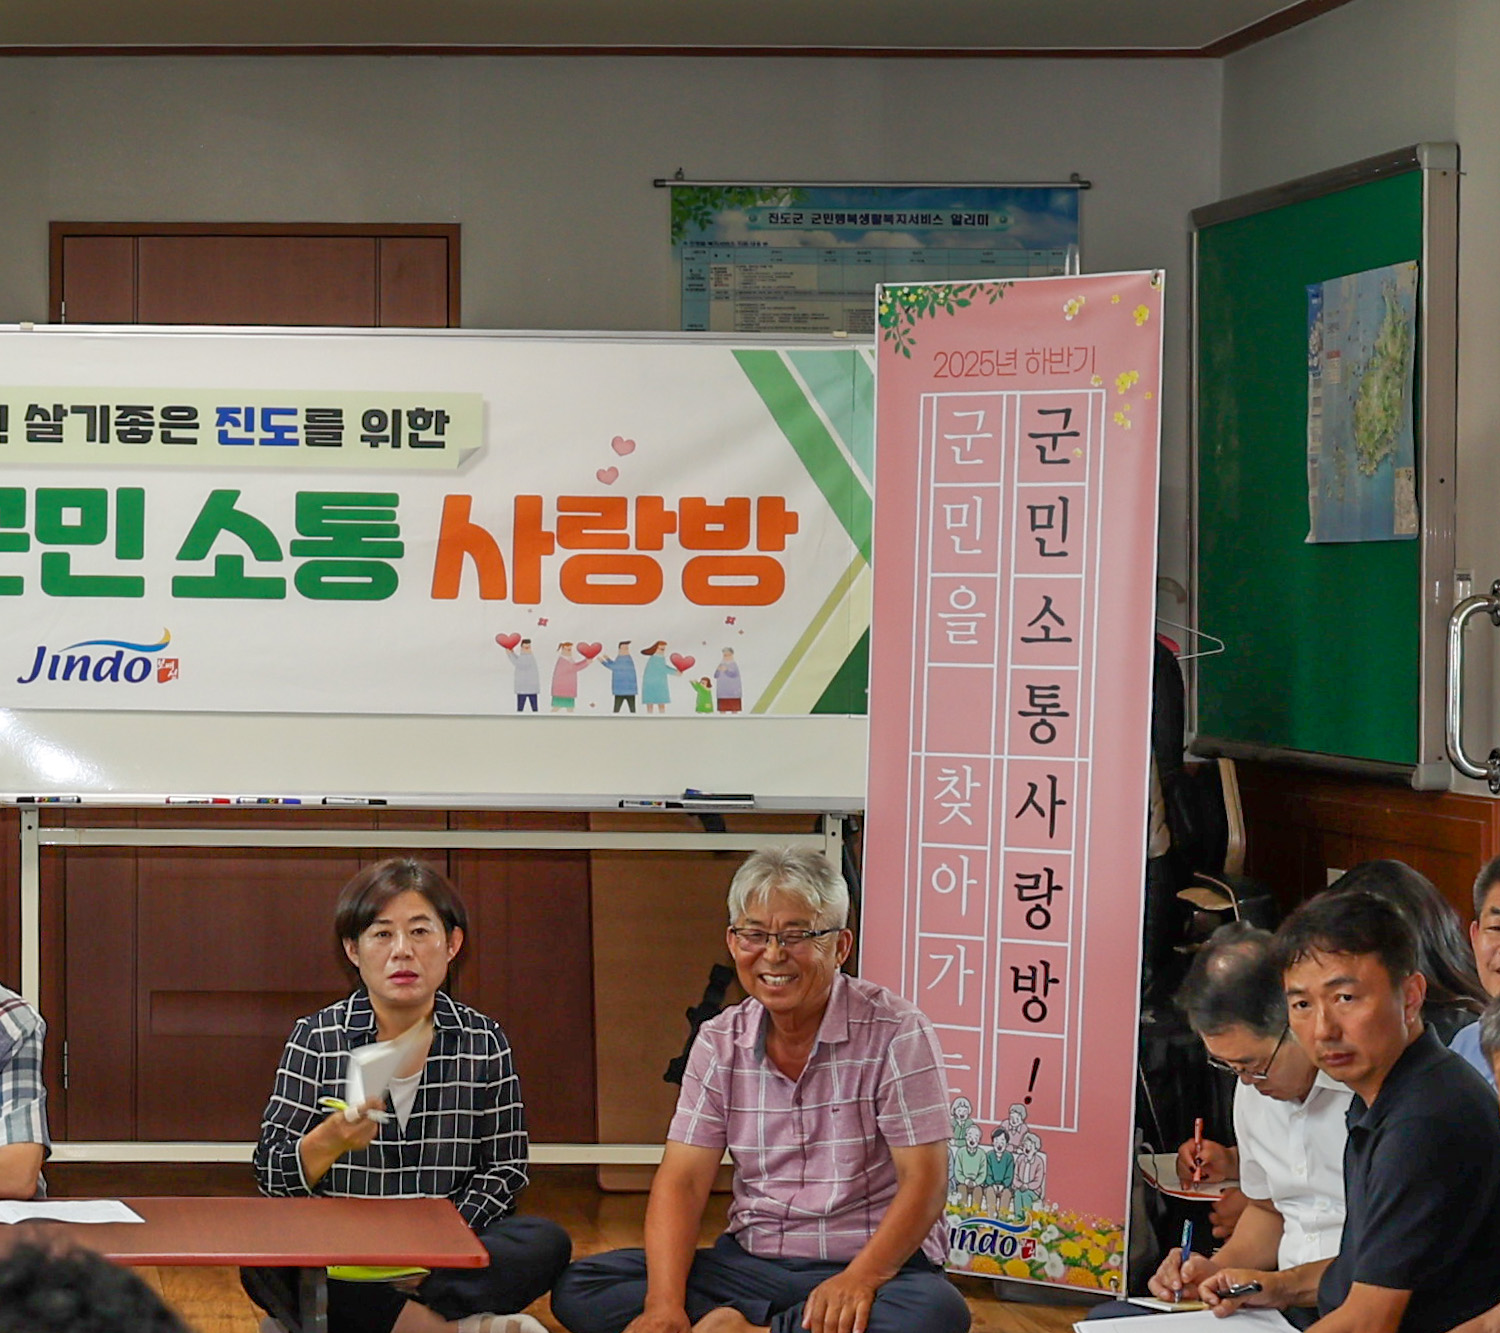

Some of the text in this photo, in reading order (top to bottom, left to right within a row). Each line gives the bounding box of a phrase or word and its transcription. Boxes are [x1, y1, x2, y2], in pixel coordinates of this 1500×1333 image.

[768, 212, 804, 225] 진도군
[951, 213, 990, 226] 알리미
[933, 345, 1096, 379] 2025년 하반기
[24, 403, 200, 446] 살기좋은
[215, 406, 345, 448] 진도를
[360, 407, 450, 450] 위한
[171, 489, 405, 601] 소통
[430, 494, 799, 606] 사랑방
[16, 645, 153, 685] Jindo
[950, 1227, 1018, 1257] indo
